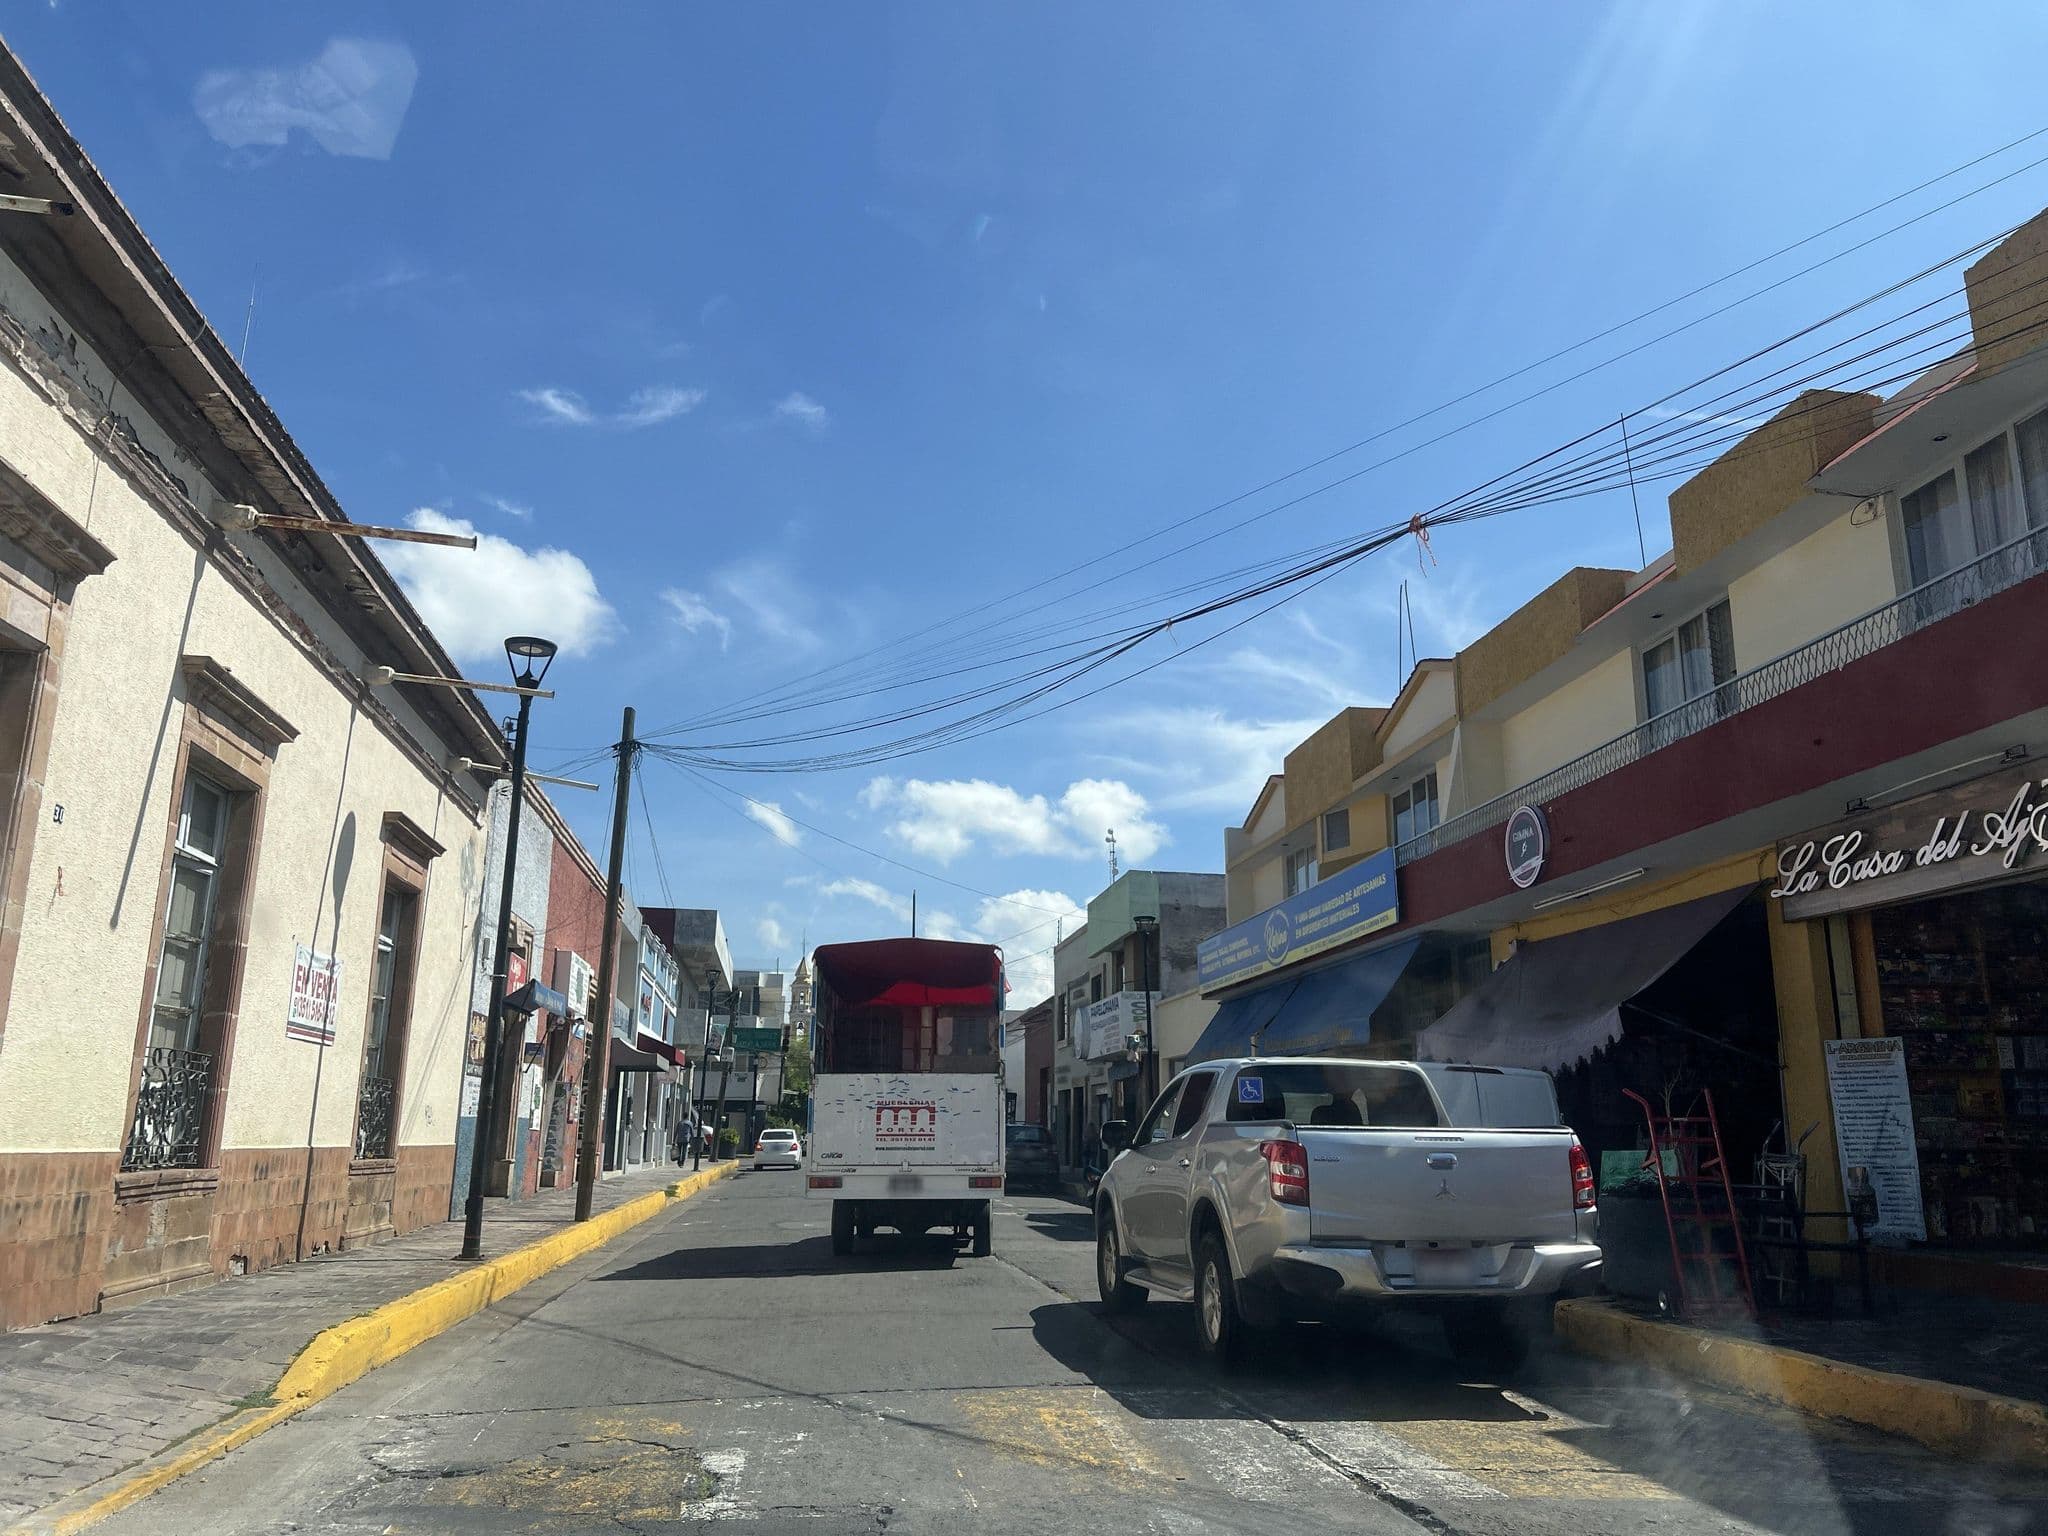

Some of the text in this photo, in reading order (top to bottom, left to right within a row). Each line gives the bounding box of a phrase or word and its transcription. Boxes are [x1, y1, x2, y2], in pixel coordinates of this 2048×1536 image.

[54, 805, 65, 823] 30
[1771, 841, 1819, 898] La
[1822, 830, 1904, 889] Casa
[1916, 810, 1970, 866] del
[1345, 889, 1353, 903] DE
[295, 964, 338, 1004] EN VENTA
